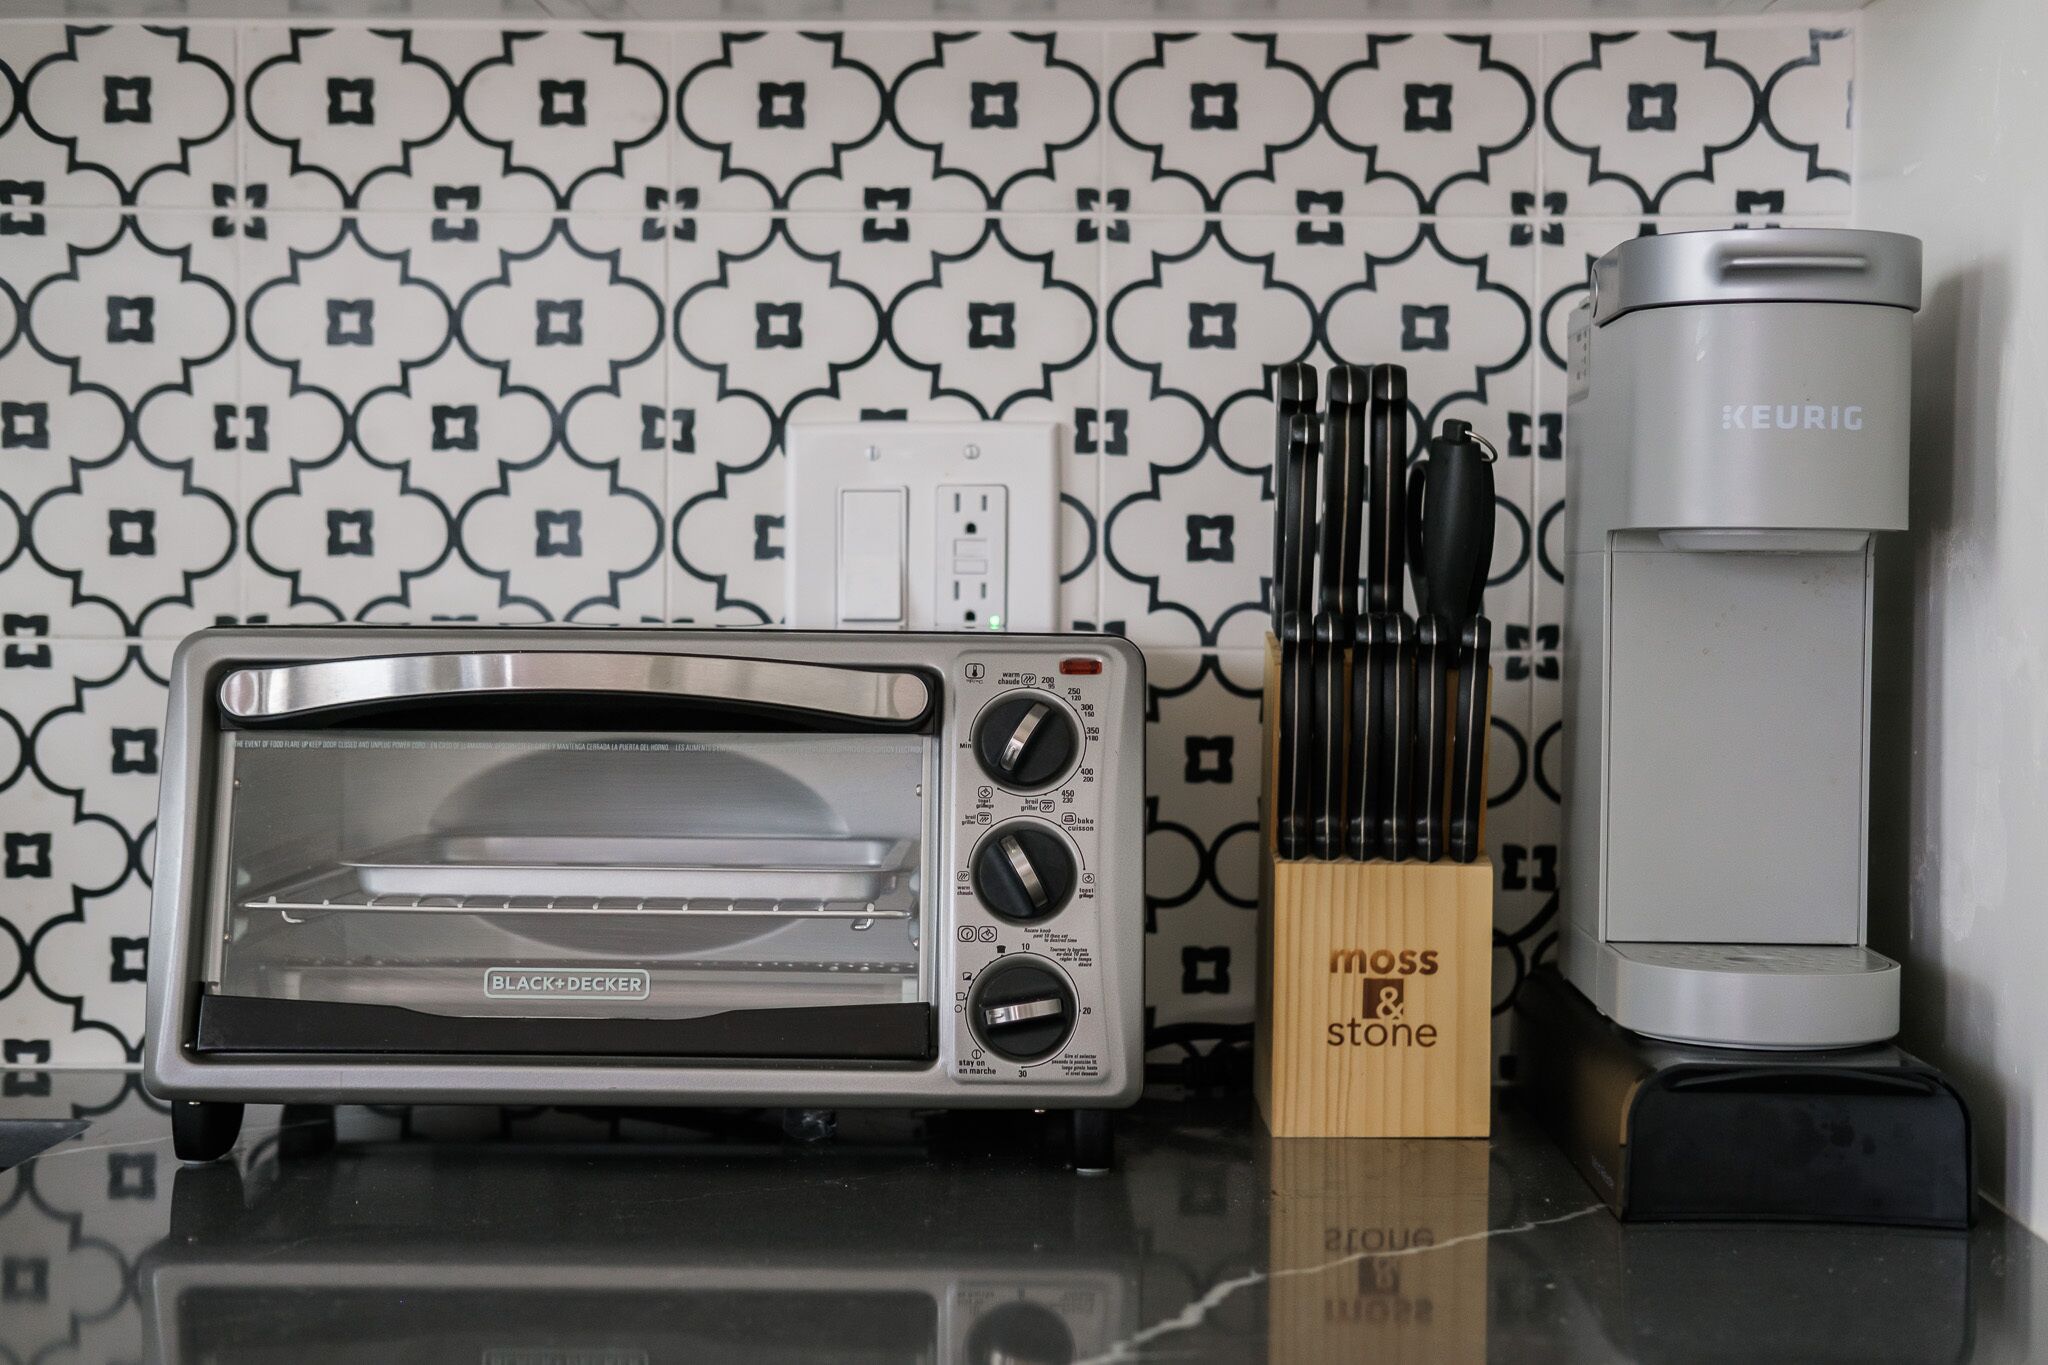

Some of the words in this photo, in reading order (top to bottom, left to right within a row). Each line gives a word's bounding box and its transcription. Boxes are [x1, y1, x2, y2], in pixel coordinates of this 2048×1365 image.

[1722, 404, 1863, 430] KEURIG
[1041, 676, 1055, 684] 200
[1330, 949, 1439, 976] moss
[492, 976, 642, 992] BLACK+DECKER
[1376, 986, 1404, 1022] &
[1327, 1018, 1438, 1048] stone
[1018, 1070, 1028, 1078] 30
